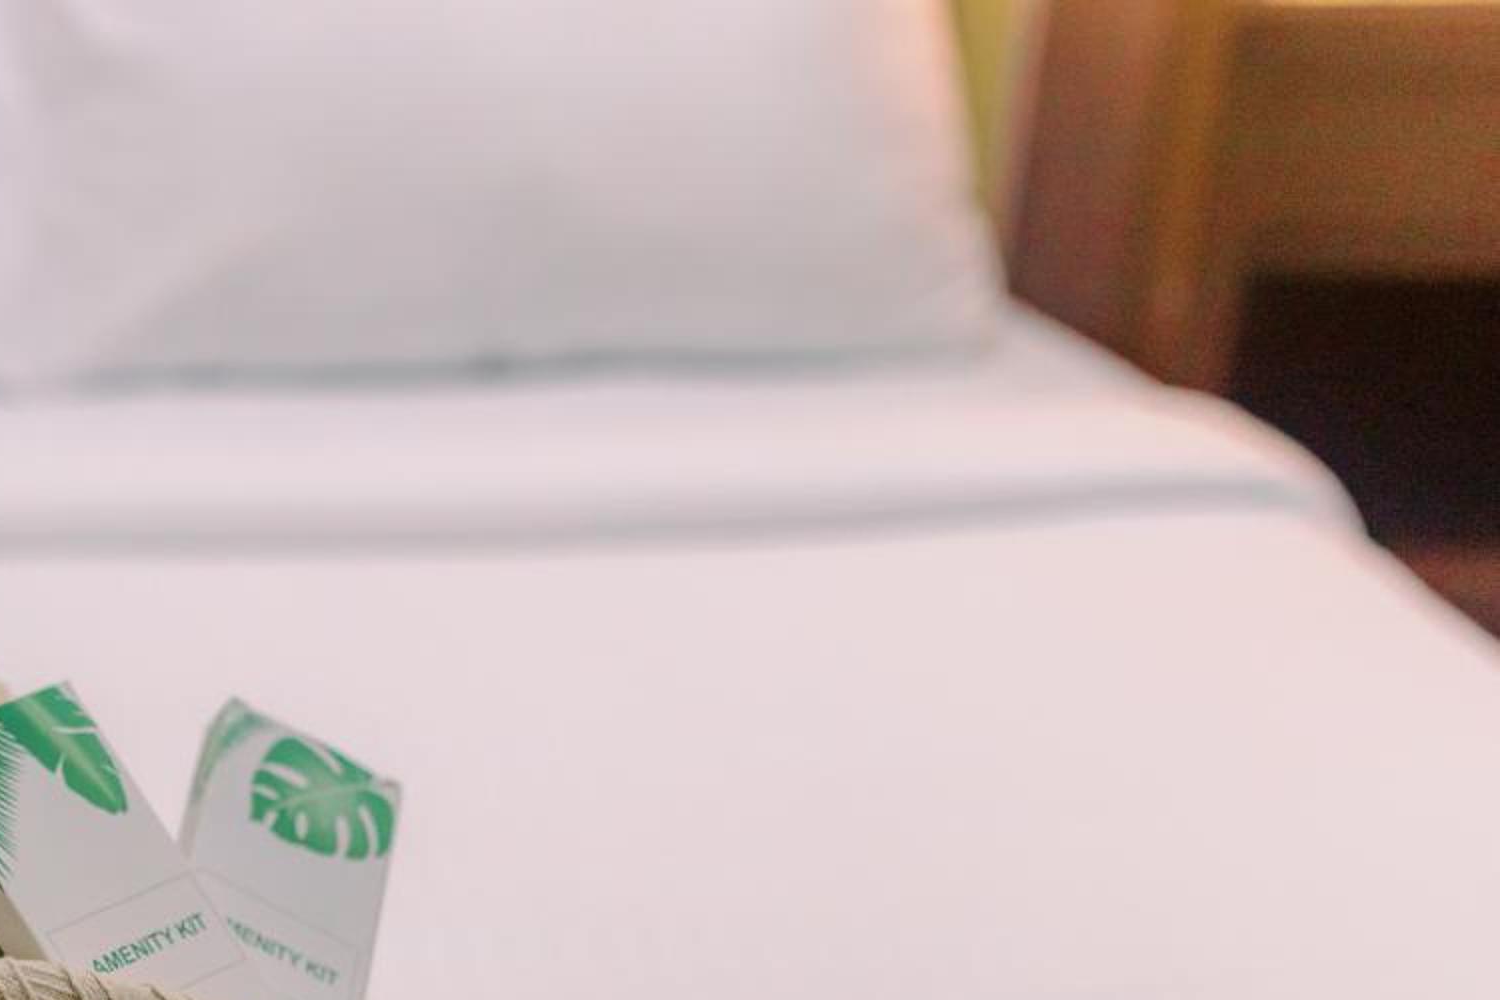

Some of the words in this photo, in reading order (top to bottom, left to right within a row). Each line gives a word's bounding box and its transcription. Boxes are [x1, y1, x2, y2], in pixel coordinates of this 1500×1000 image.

[92, 926, 174, 973] AMENITY
[174, 912, 207, 939] KIT
[226, 916, 303, 966] MENITY
[304, 959, 338, 985] KIT
